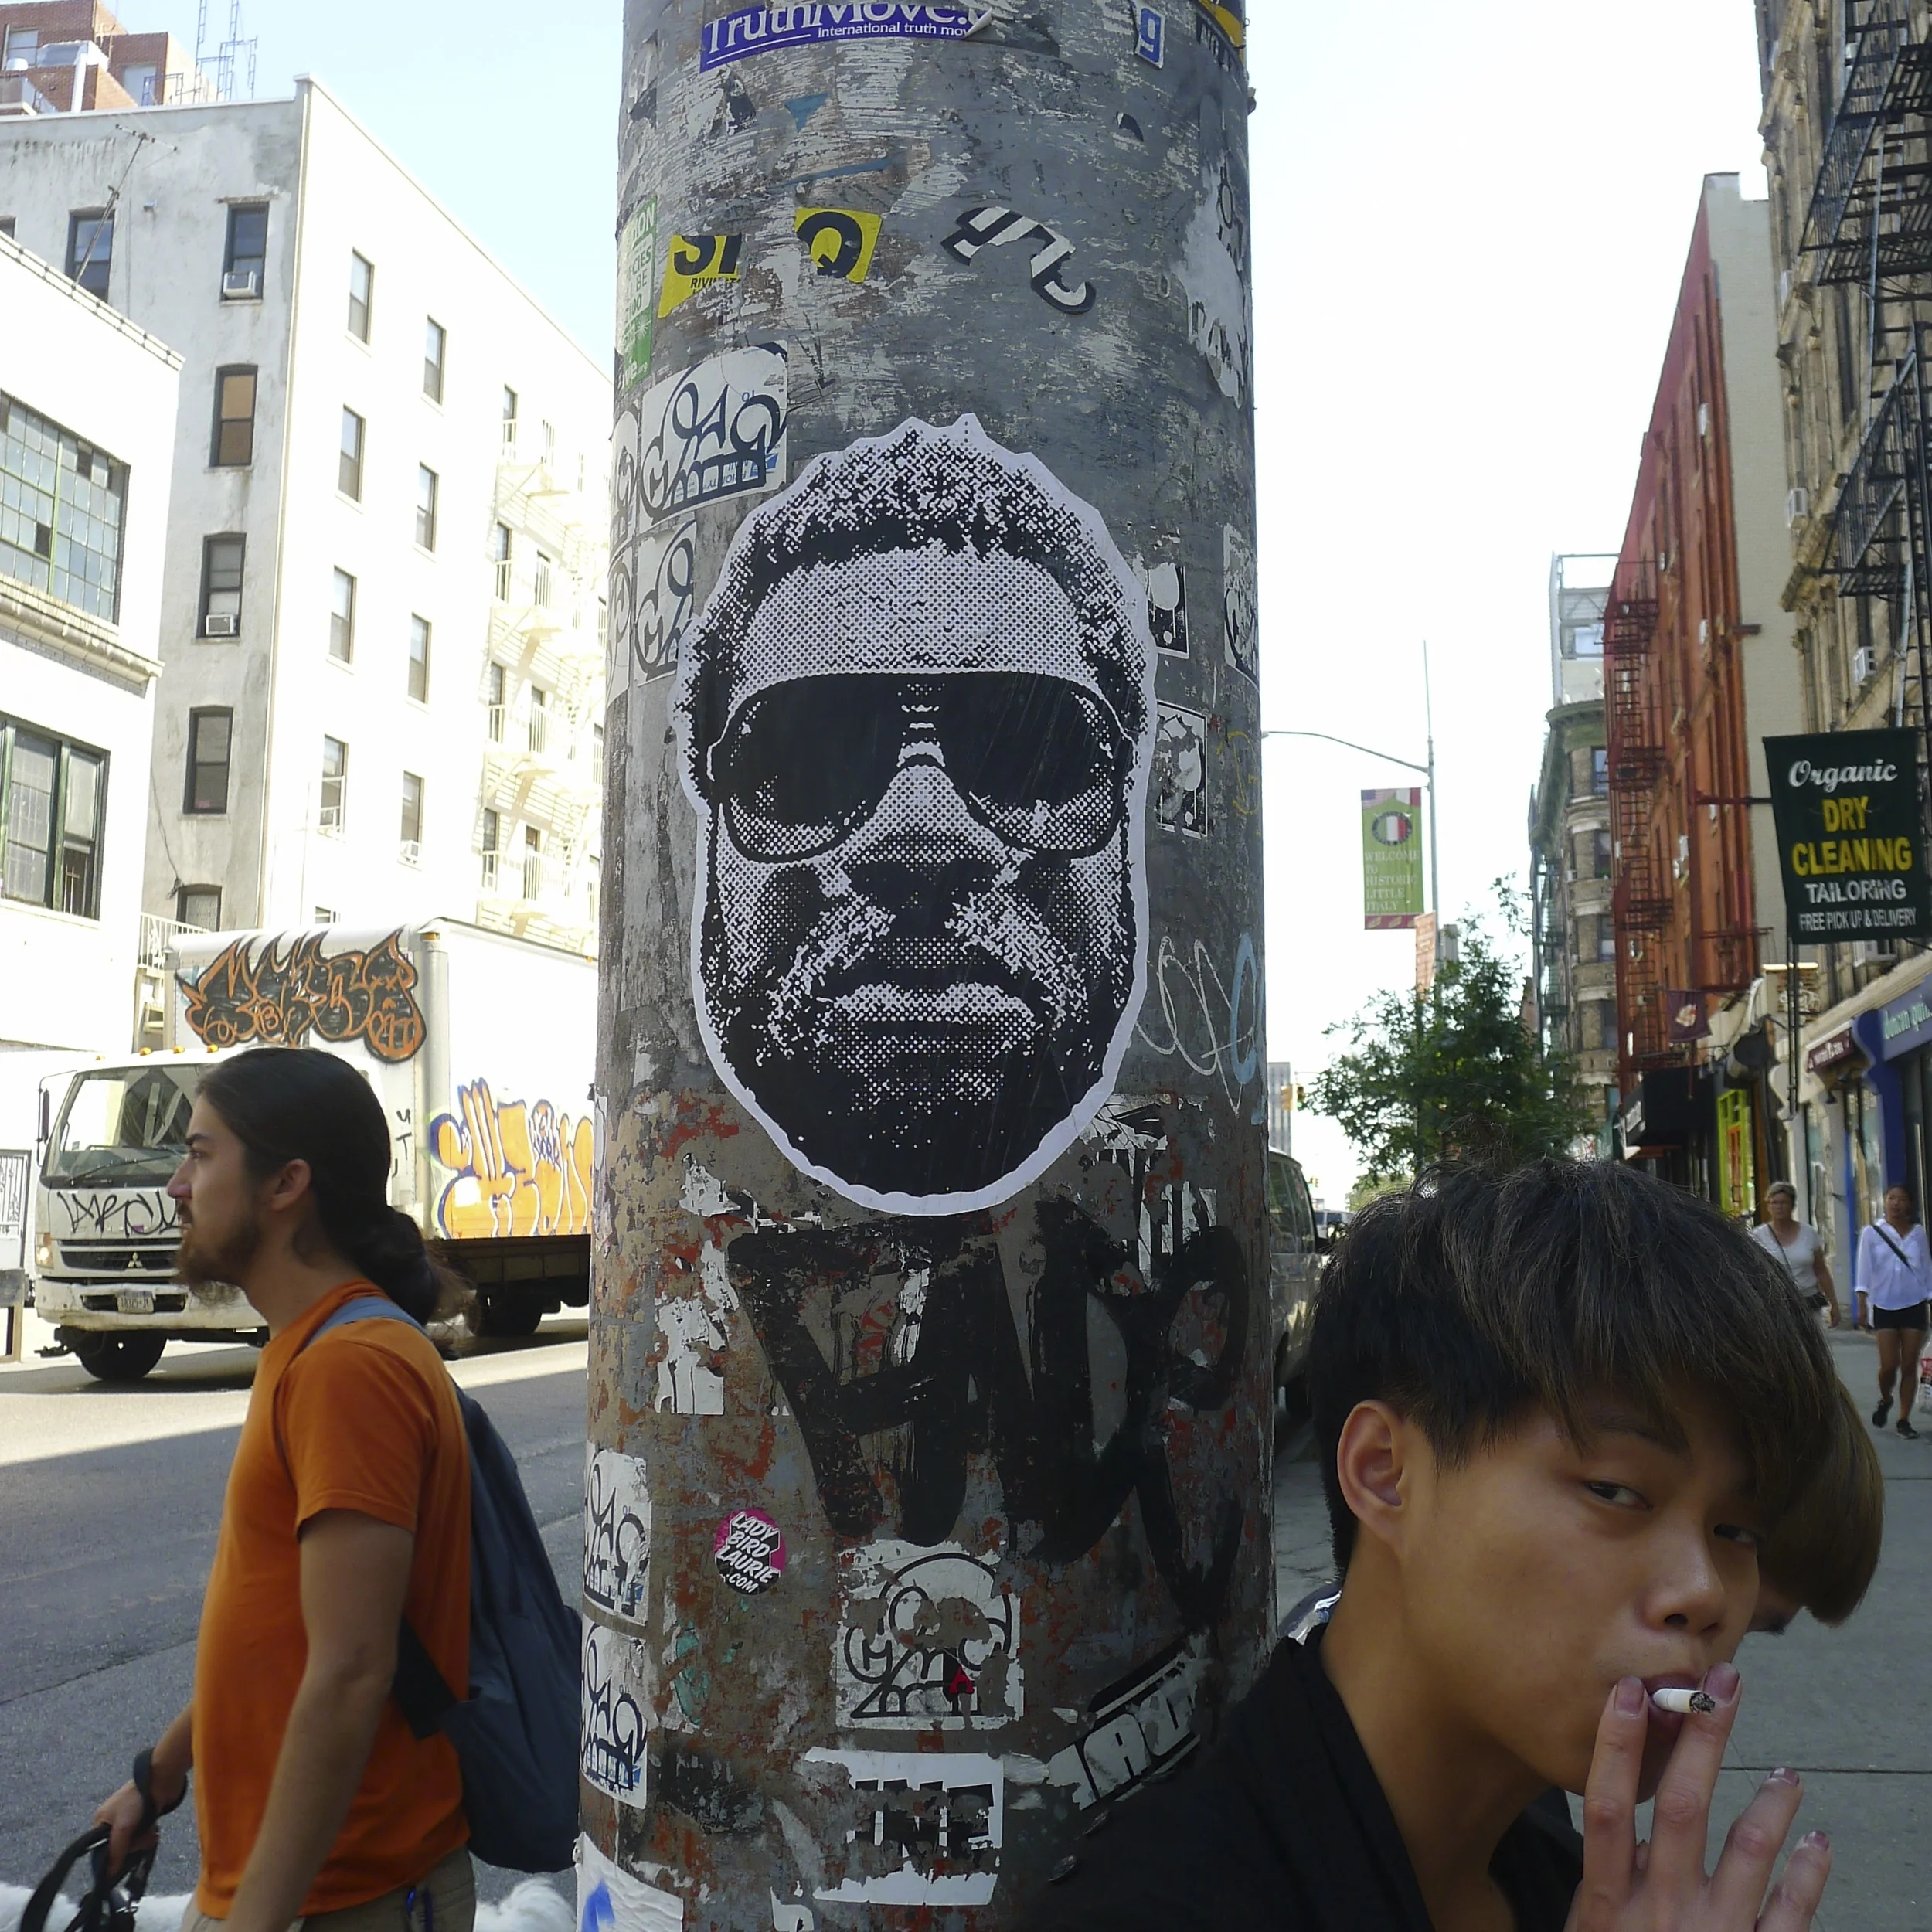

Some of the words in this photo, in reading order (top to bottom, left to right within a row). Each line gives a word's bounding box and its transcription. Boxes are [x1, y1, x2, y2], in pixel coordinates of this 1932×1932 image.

[818, 22, 900, 38] International
[903, 22, 937, 34] truth
[1788, 759, 1898, 793] Organic
[1821, 796, 1869, 832] DRY
[1365, 850, 1420, 862] WELCOME
[1791, 836, 1913, 876] CLEANING
[1366, 865, 1378, 875] TO
[1366, 875, 1417, 886] HISTORIC
[1366, 887, 1405, 899] LITTLE
[1804, 879, 1906, 903] TAILORING
[1366, 900, 1400, 912] ITALY
[1799, 912, 1825, 931] FREE
[1825, 910, 1849, 930] PICK
[1850, 909, 1863, 928] UP
[1872, 906, 1917, 927] DELIVERY
[731, 1512, 779, 1542] LADY
[727, 1530, 770, 1557] BIRD
[716, 1545, 779, 1583] LAURIE
[726, 1573, 759, 1593] .COM
